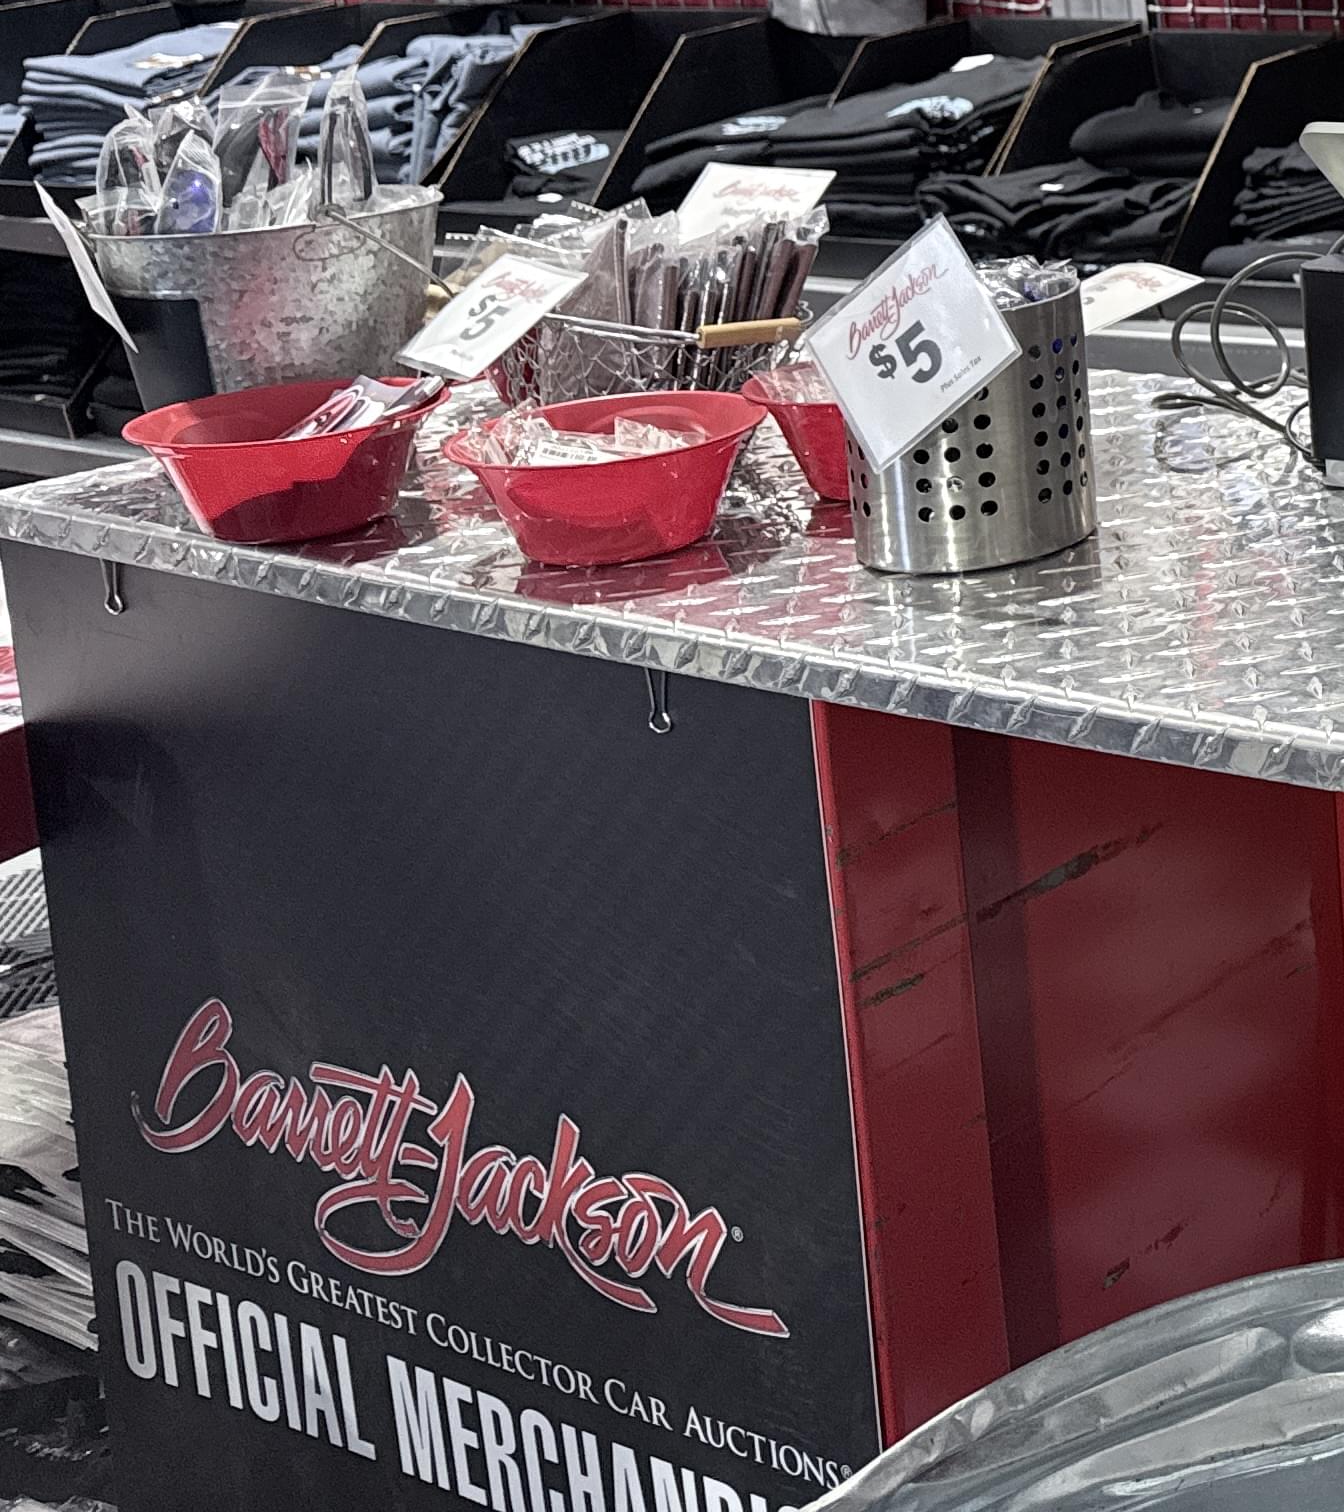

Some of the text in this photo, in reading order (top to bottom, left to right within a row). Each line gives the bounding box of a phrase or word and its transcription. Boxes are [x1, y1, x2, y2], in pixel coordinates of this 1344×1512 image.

[459, 293, 511, 341] $5
[847, 263, 949, 360] Barrett-Jackson
[869, 319, 942, 384] $5
[941, 355, 982, 392] Plus Sales Tax
[105, 1199, 160, 1244] THE
[164, 1216, 280, 1285] WORLD'S
[286, 1262, 419, 1337] GREATEST
[426, 1312, 600, 1405] COLLECTOR
[603, 1378, 675, 1433] CAR
[115, 1259, 378, 1463] OFFICIAL
